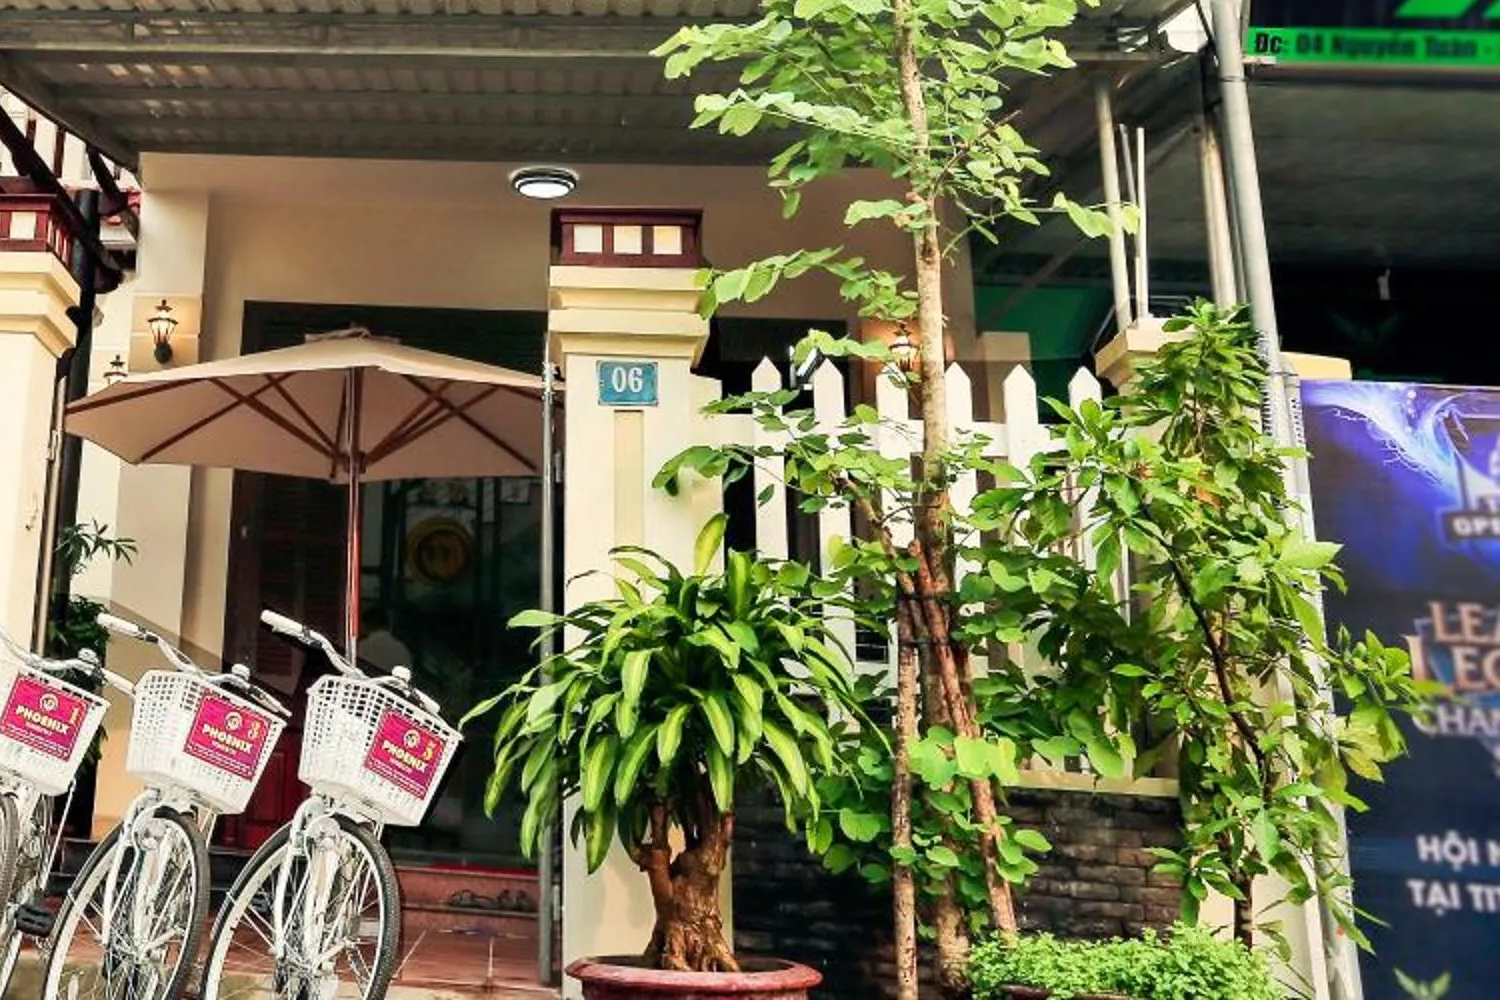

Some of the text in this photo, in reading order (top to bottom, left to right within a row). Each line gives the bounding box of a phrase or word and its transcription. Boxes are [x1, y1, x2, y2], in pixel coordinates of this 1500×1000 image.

[611, 366, 645, 394] 06
[1428, 602, 1500, 643] LE
[15, 704, 70, 735] PHOENIX
[202, 722, 253, 754] PHOENIX
[382, 739, 429, 774] PHOENIX
[1415, 829, 1480, 873] HỘI
[1406, 877, 1463, 917] TẠI
